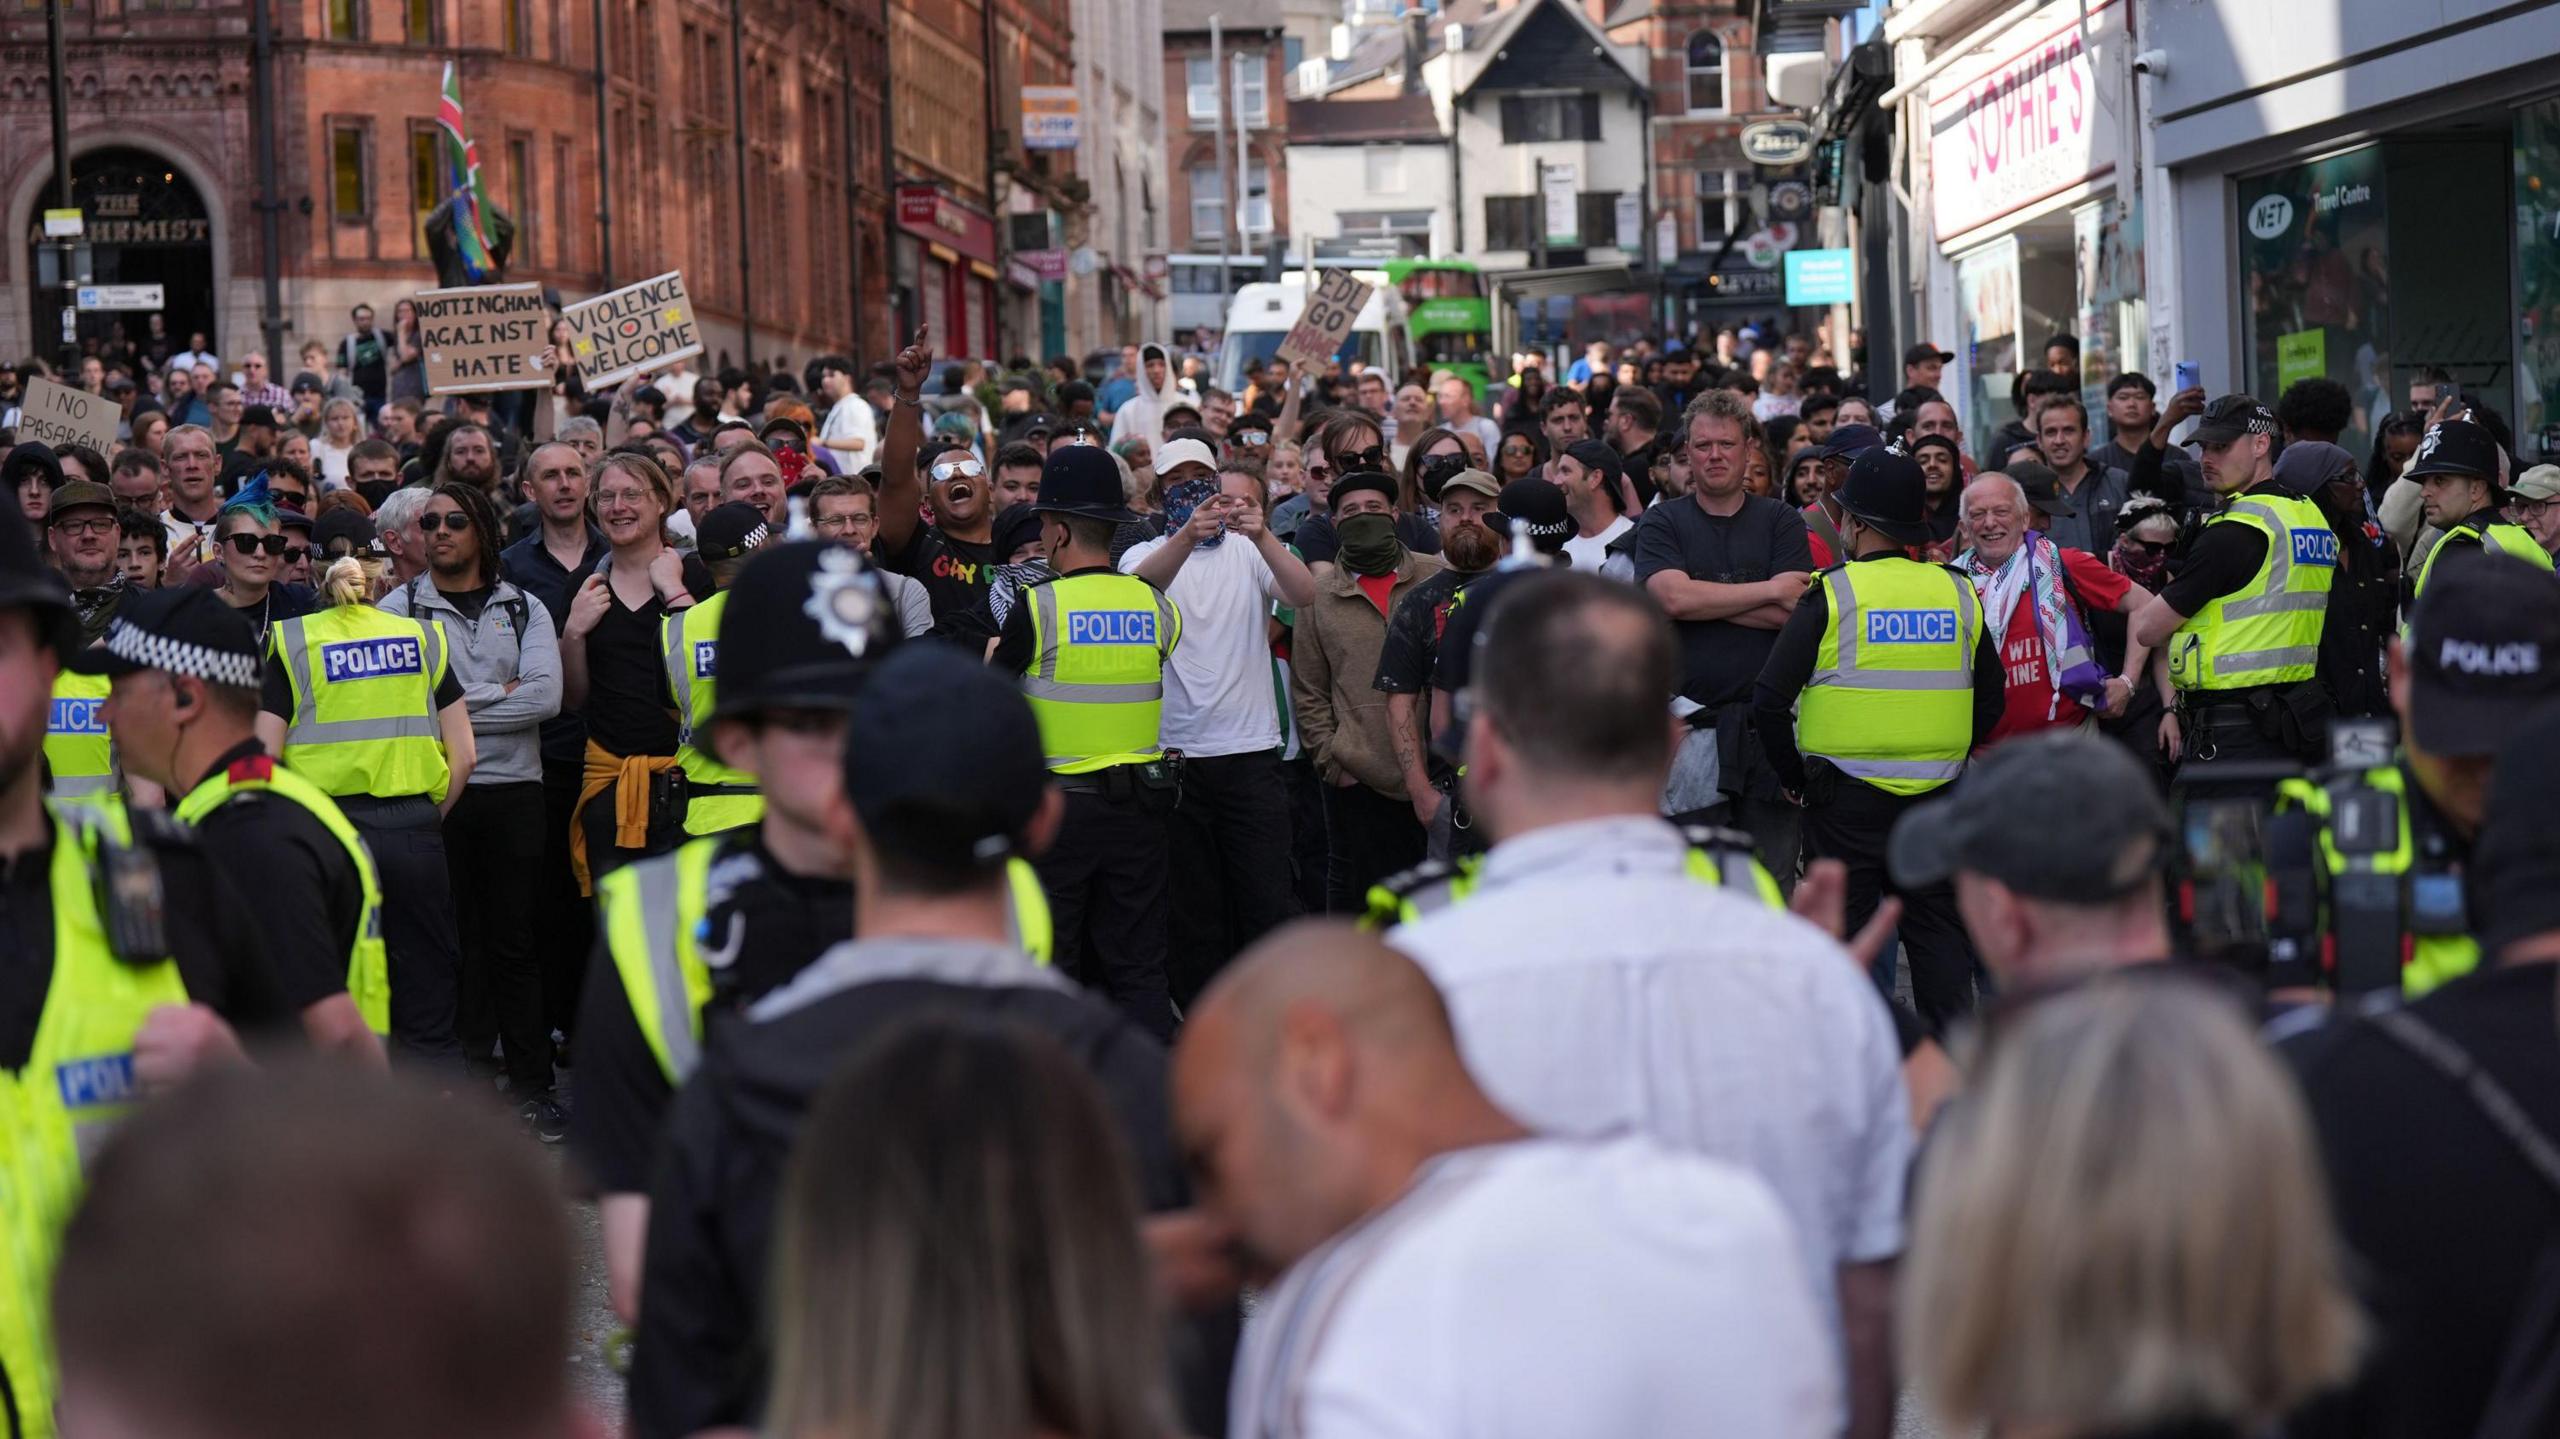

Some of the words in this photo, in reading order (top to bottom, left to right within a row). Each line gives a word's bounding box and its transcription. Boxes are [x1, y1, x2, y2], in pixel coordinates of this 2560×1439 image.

[2256, 202, 2286, 229] NET
[417, 294, 543, 318] NOTTINGHAM
[566, 275, 684, 334] VIOLENCE
[1316, 267, 1364, 315] EDL
[591, 308, 665, 351] NOT
[1308, 302, 1345, 332] GO
[424, 320, 538, 347] AGAINST
[577, 322, 696, 377] WELCOME
[453, 354, 521, 377] HATE
[932, 554, 977, 584] GAY
[1072, 613, 1154, 641] POLICE
[1871, 613, 1953, 640] POLICE
[329, 643, 418, 676] POLICE
[2008, 636, 2041, 662] WIT
[2440, 637, 2540, 675] POLICE
[2005, 660, 2041, 688] TINE
[47, 700, 104, 730] LICE
[65, 1057, 132, 1105] POL
